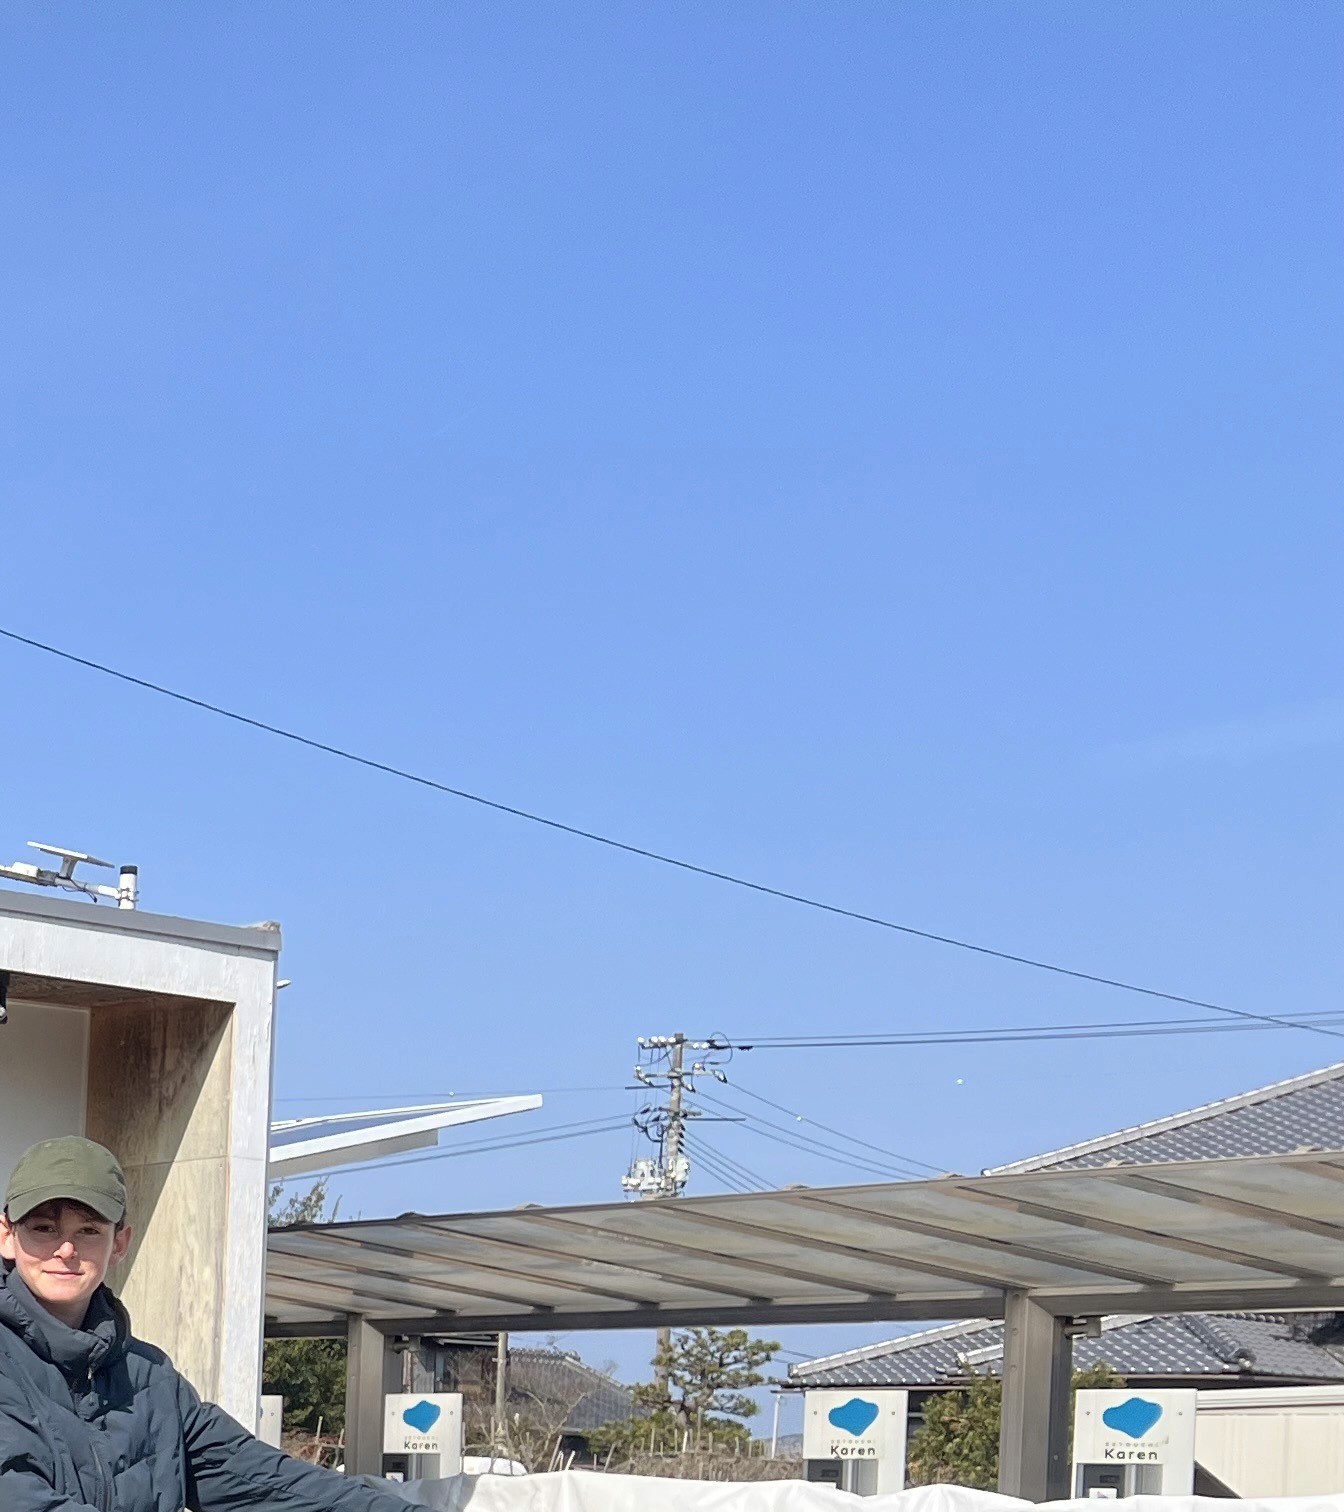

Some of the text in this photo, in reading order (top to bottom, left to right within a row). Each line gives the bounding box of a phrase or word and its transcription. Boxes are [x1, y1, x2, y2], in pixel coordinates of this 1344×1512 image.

[404, 1441, 438, 1450] Karen
[830, 1445, 876, 1456] Karen
[1104, 1448, 1158, 1460] Karen
